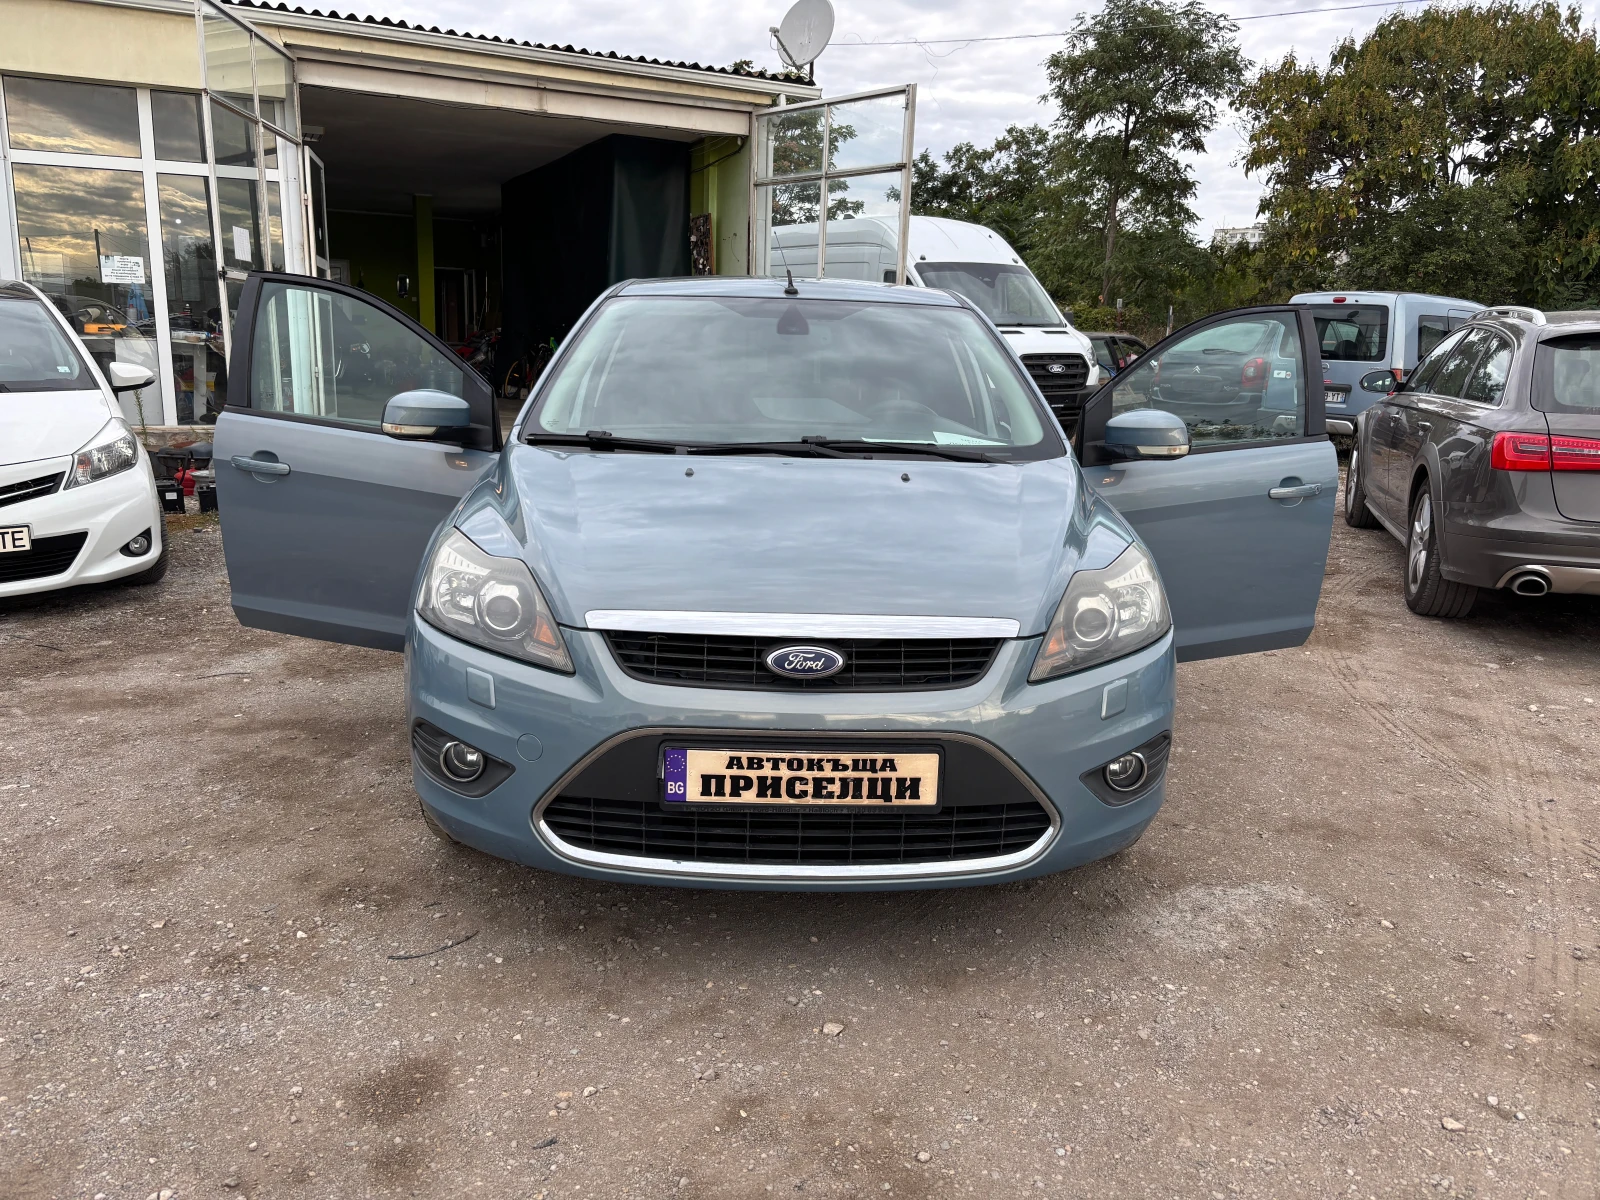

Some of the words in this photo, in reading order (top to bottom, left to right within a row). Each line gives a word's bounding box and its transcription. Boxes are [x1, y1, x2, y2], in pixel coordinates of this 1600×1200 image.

[0, 530, 26, 550] TE
[784, 652, 826, 670] Ford
[725, 756, 898, 773] АВТОКЪЩА
[667, 781, 684, 794] BG
[700, 774, 922, 802] ПРИСЕЛЦИ
